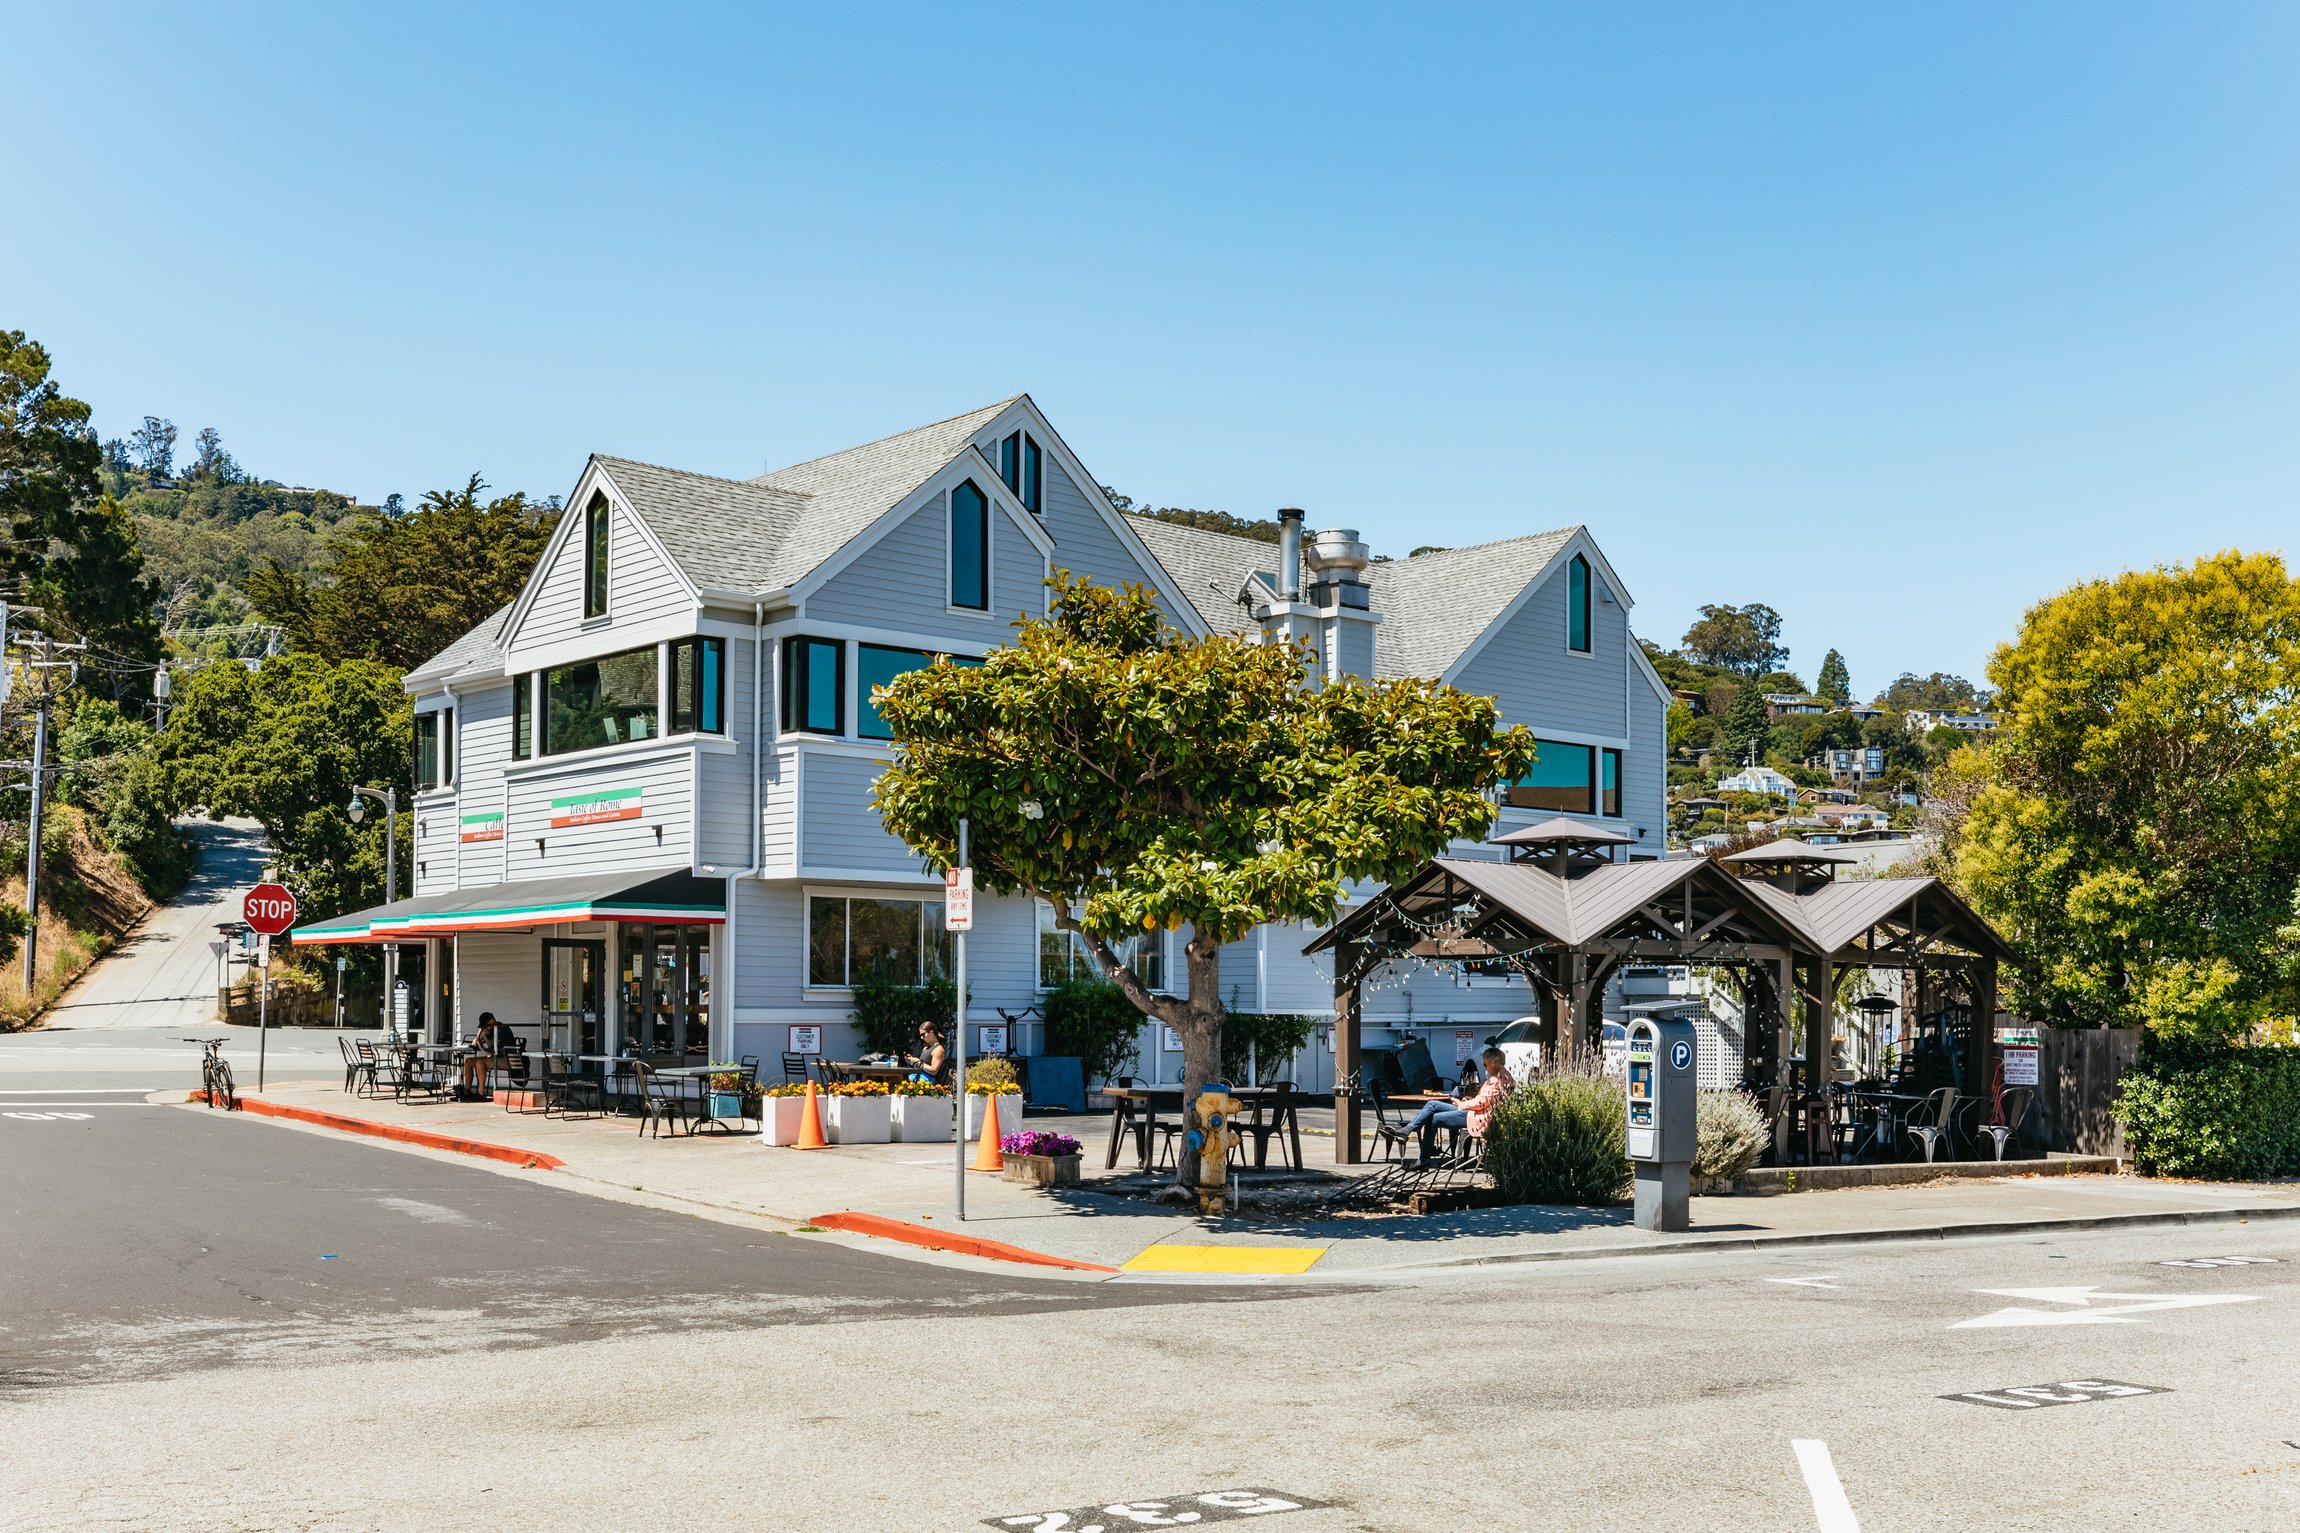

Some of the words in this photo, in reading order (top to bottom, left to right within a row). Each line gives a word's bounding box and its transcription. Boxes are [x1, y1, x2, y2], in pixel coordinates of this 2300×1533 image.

[569, 803, 587, 815] Taste
[588, 796, 599, 813] of
[600, 799, 622, 811] Rome
[948, 870, 957, 884] NO
[950, 889, 969, 900] PARKING
[247, 898, 292, 919] STOP
[1676, 1046, 1688, 1065] P
